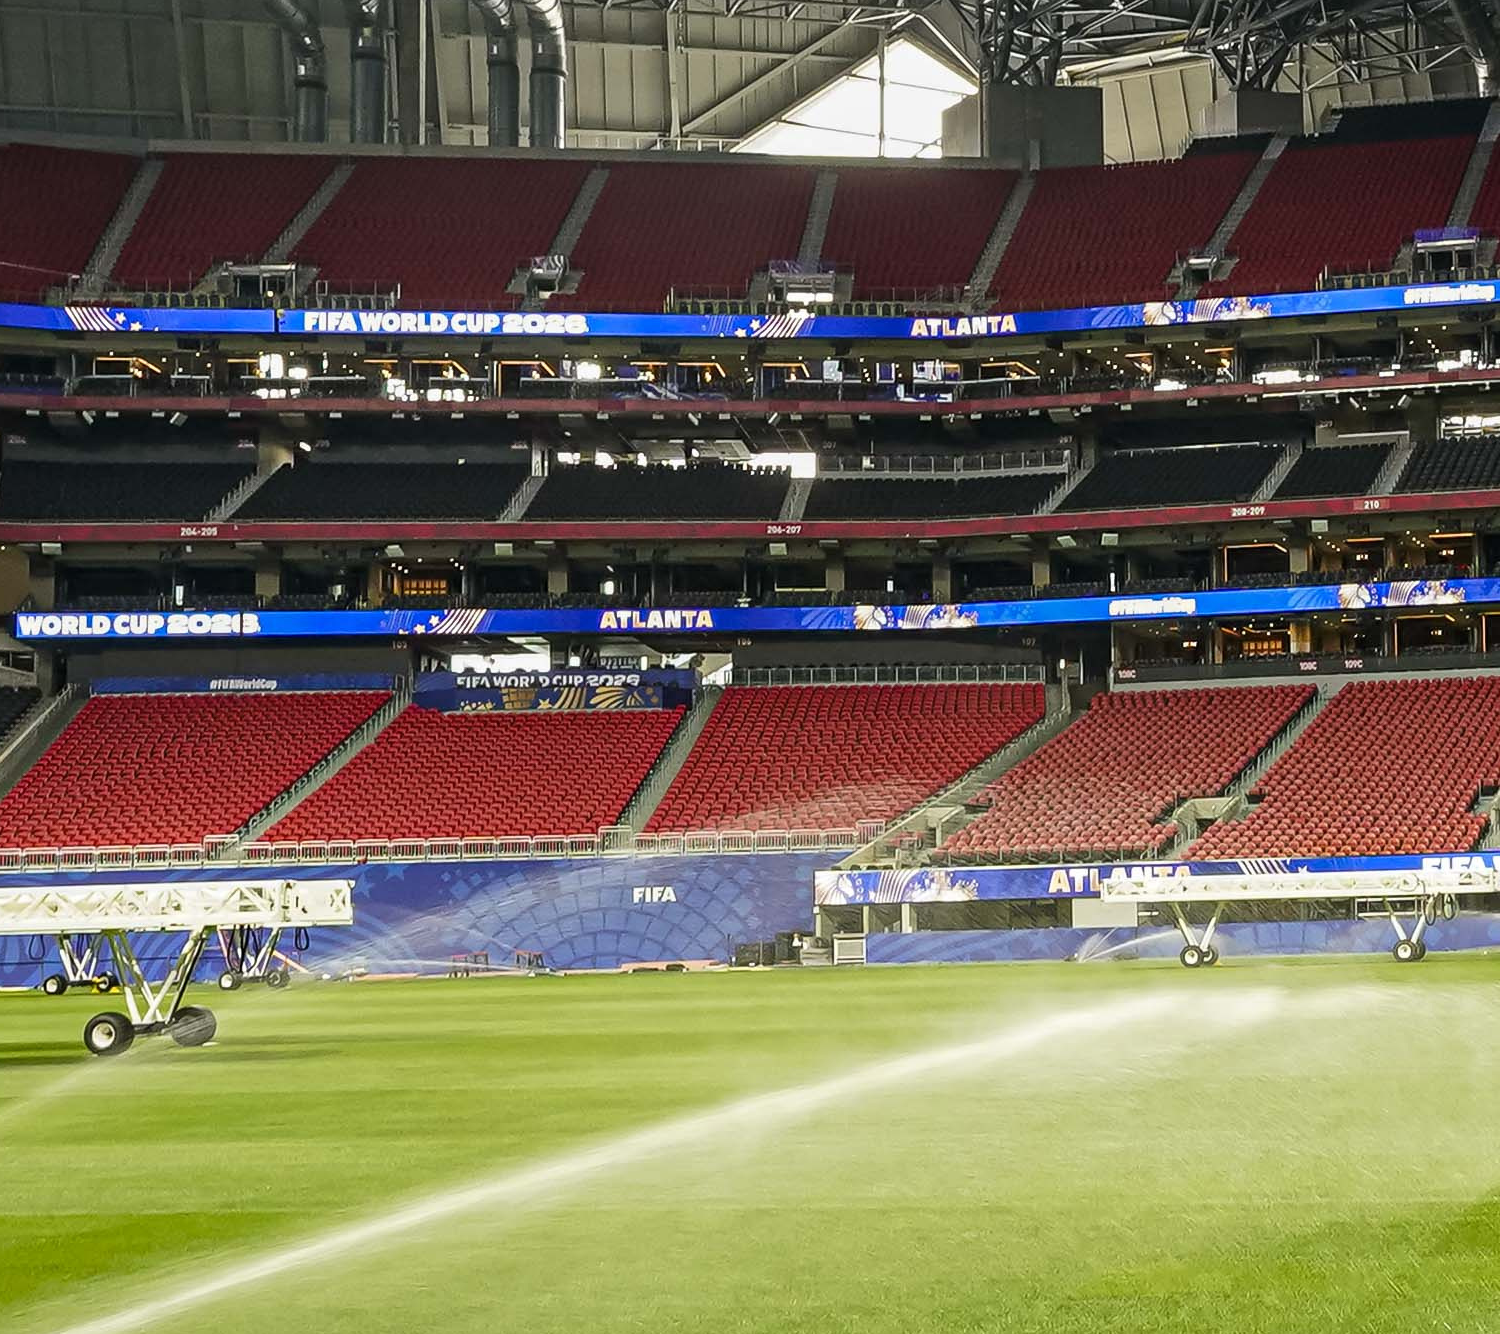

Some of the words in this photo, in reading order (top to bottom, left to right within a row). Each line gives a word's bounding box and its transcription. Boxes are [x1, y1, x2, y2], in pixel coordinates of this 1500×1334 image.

[304, 312, 357, 332] FIFA
[358, 312, 449, 332] WORLD
[450, 313, 500, 333] CUP
[502, 314, 590, 334] 2026
[911, 314, 1018, 336] ATLANTA
[1363, 500, 1380, 509] 210
[180, 527, 218, 536] 204-205
[766, 525, 802, 534] 206-207
[18, 615, 111, 635] WORLD
[113, 614, 164, 635] CUP
[599, 609, 713, 629] ATLANTA
[456, 676, 491, 688] FIFA
[632, 885, 677, 903] FIFA
